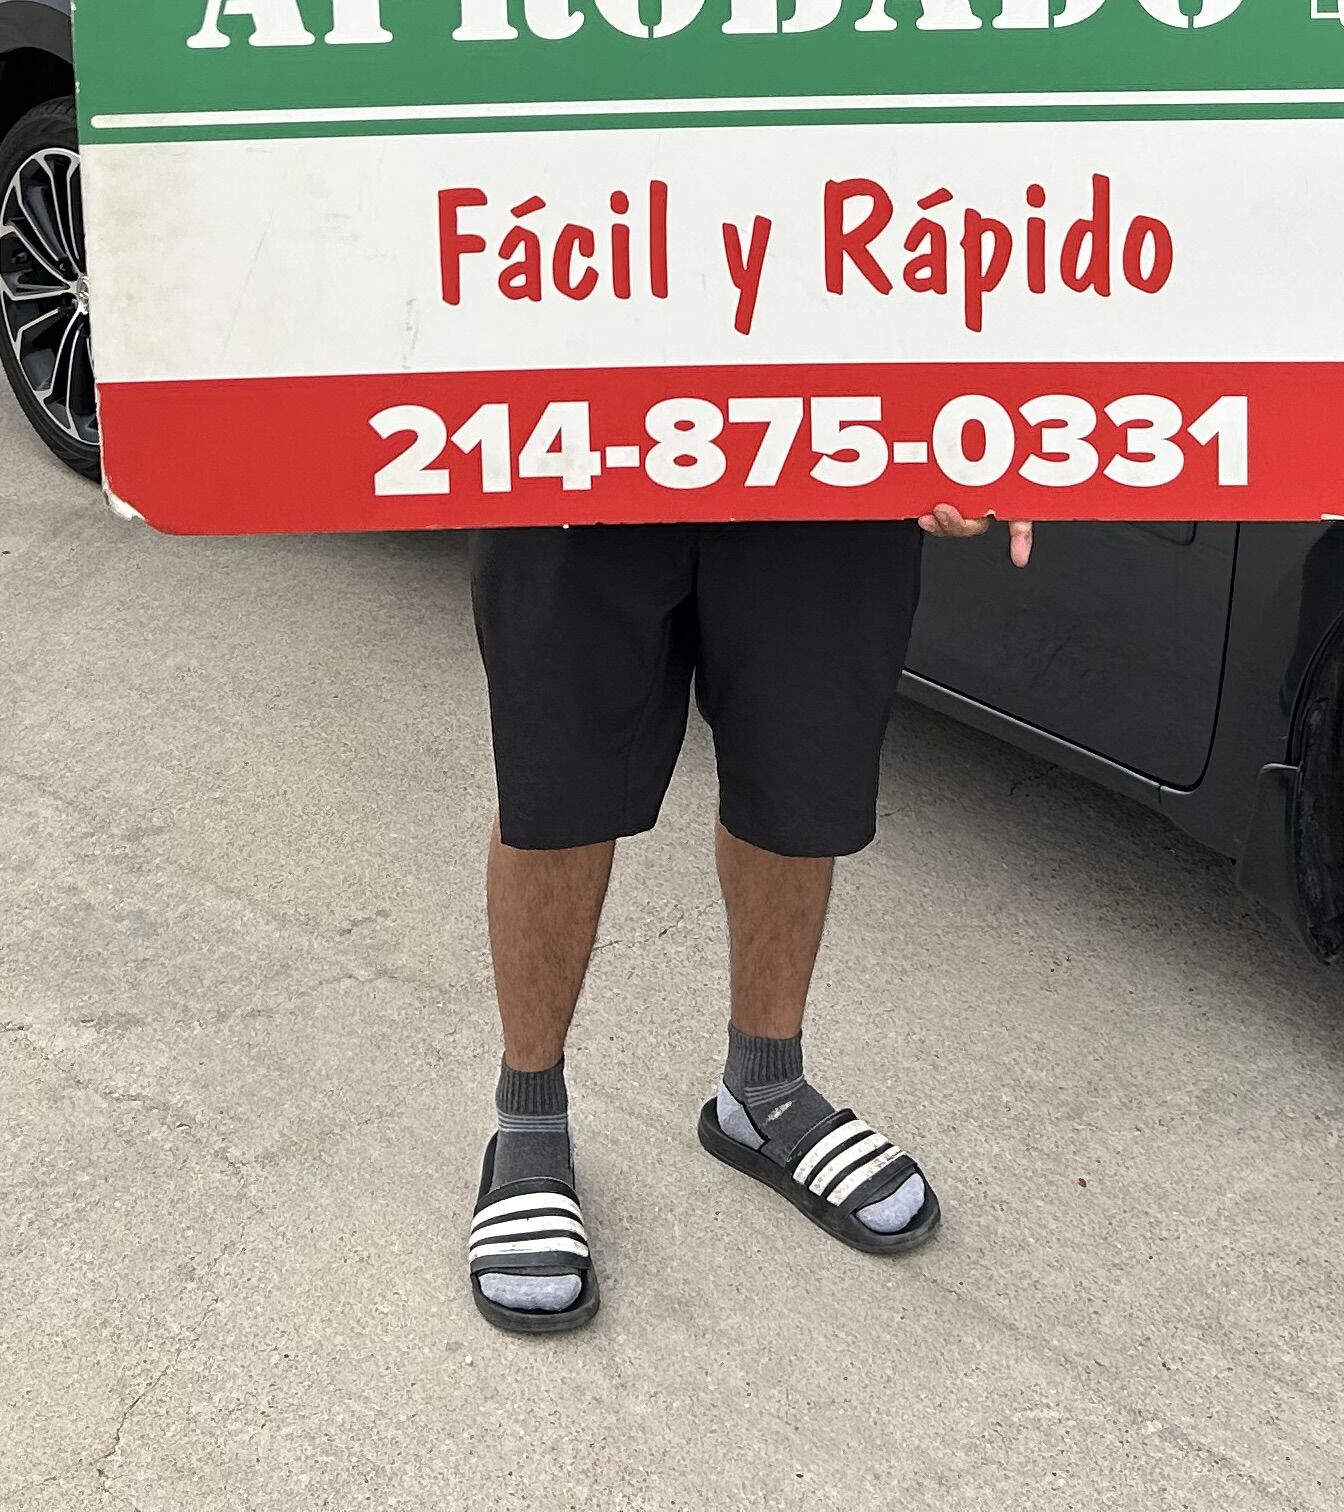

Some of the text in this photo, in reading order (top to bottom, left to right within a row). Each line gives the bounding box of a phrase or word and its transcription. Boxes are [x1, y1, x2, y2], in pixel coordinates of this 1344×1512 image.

[438, 174, 1173, 335] Fácil y Rápido
[369, 394, 1248, 496] 214-875-0331
